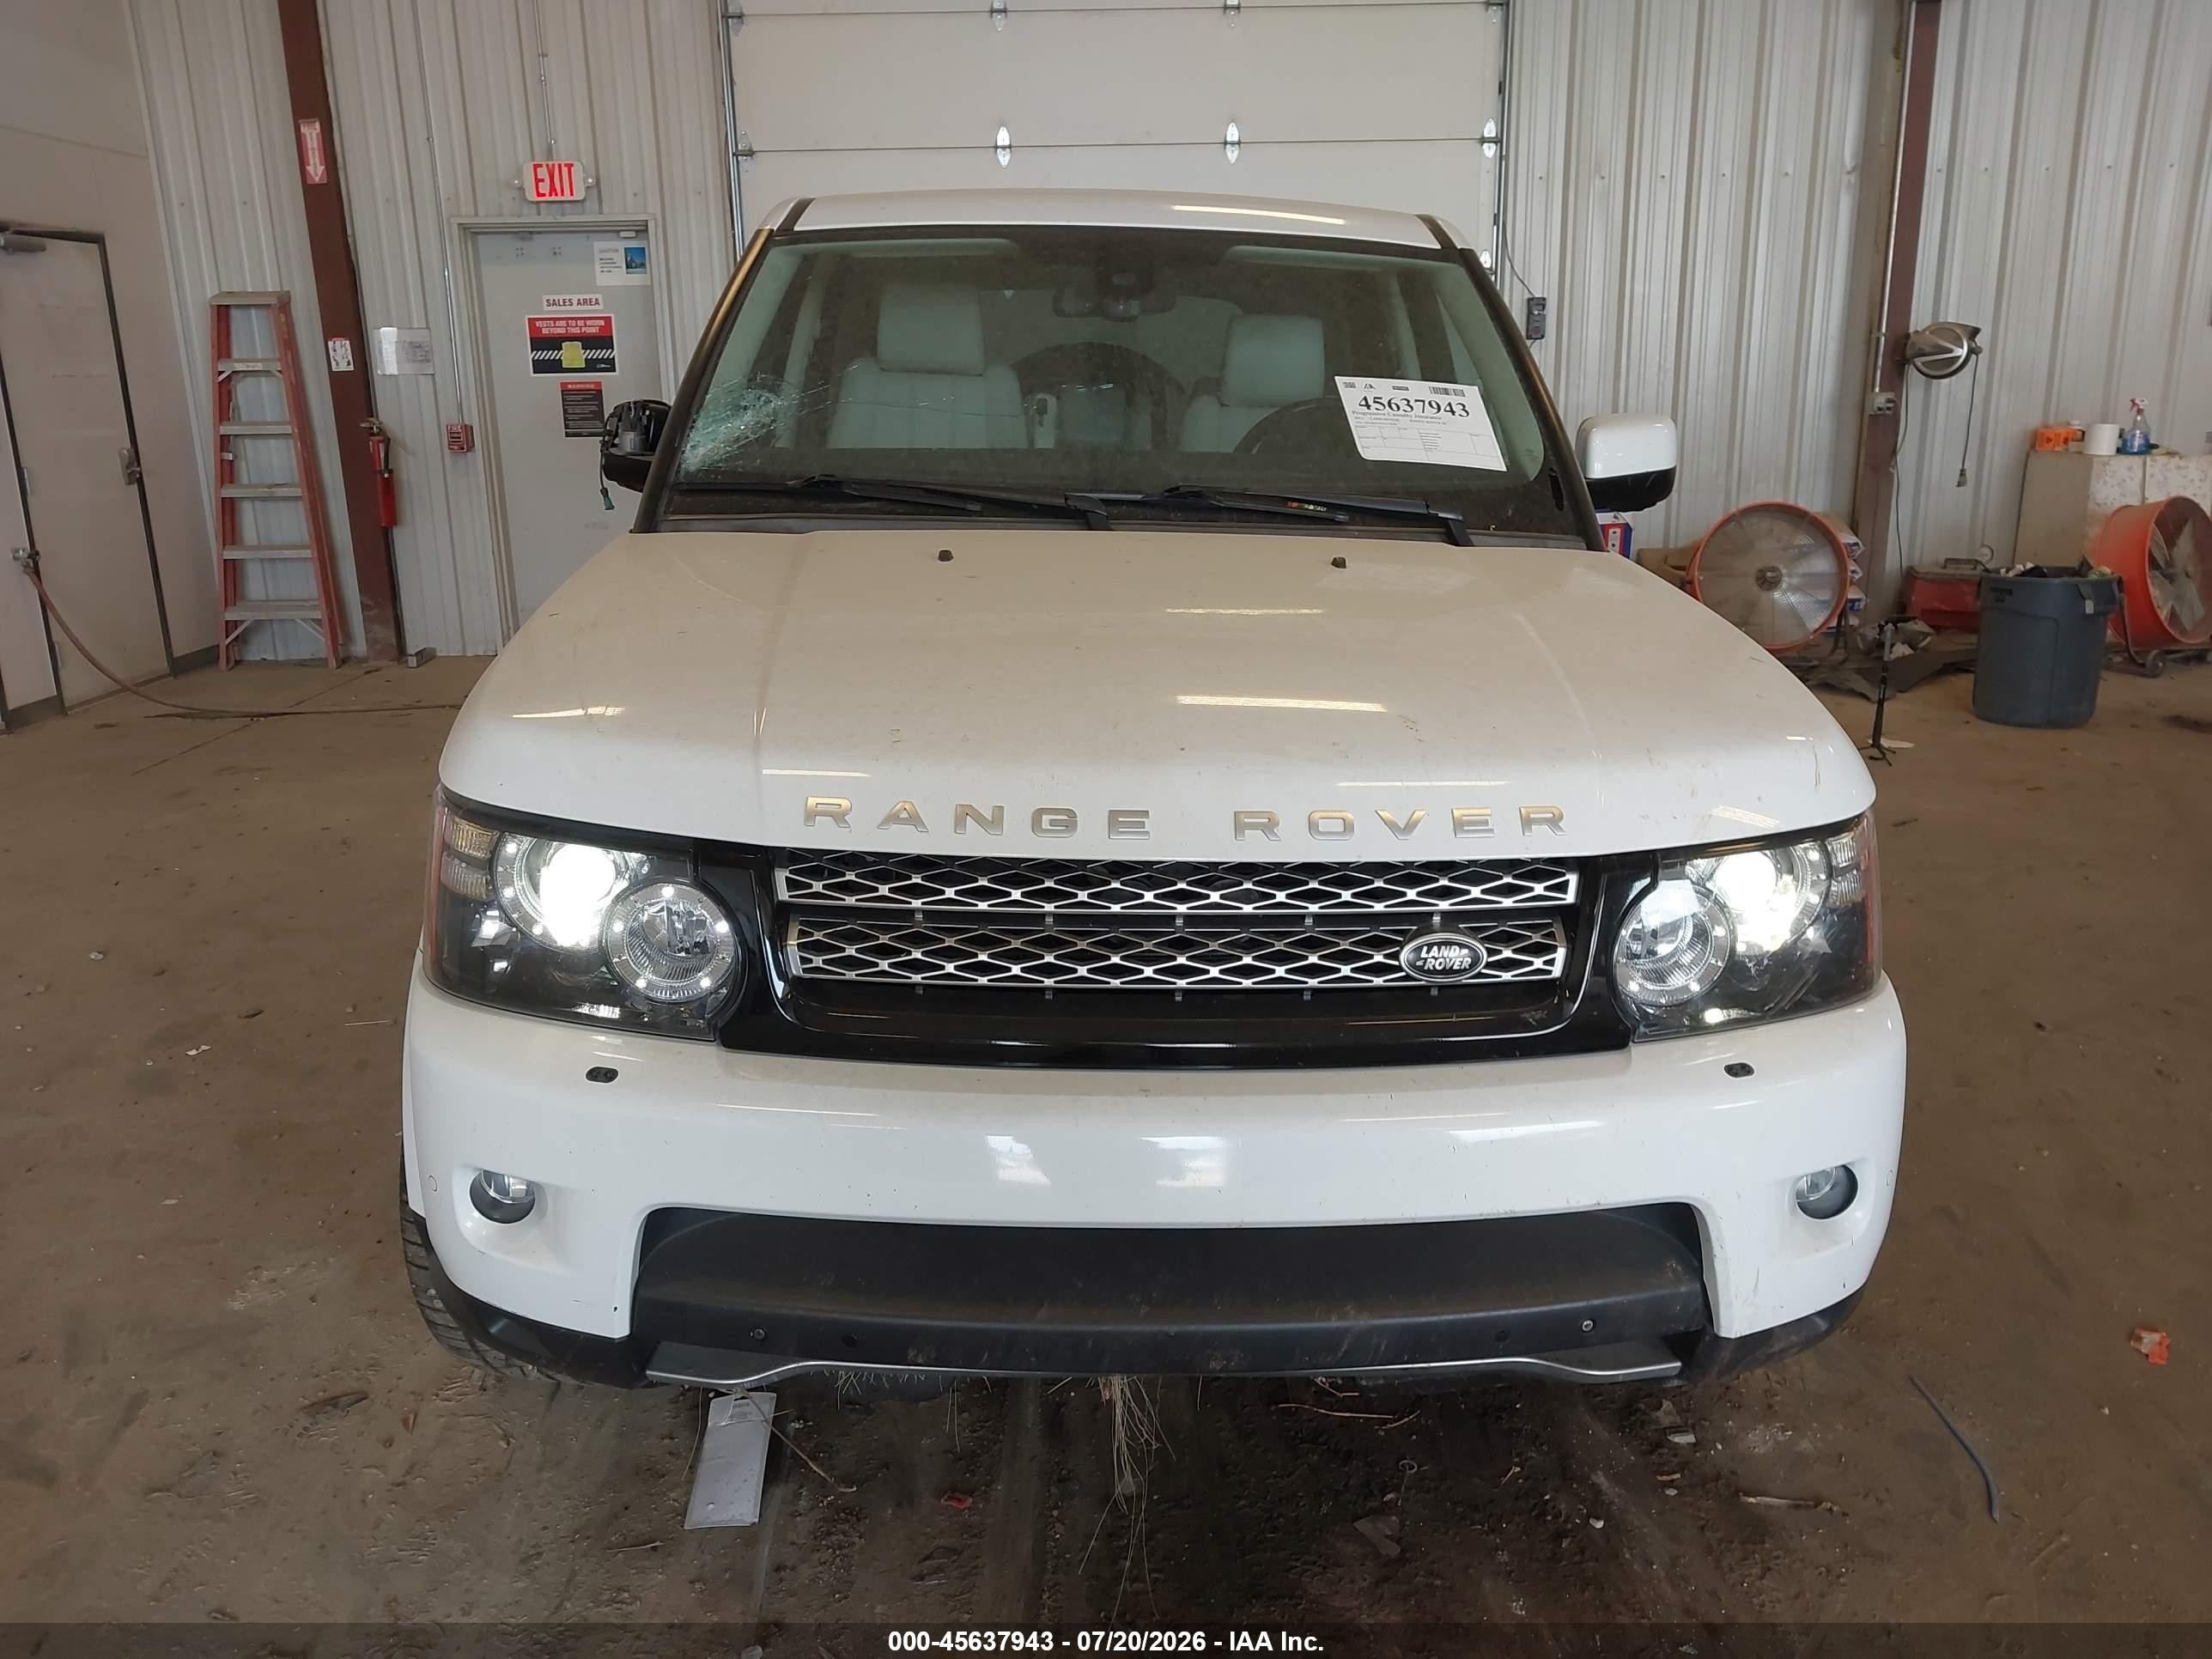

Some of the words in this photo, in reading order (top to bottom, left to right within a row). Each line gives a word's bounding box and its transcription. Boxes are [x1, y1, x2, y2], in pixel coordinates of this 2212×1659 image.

[532, 163, 574, 198] EXIT
[545, 298, 574, 307] SALES
[576, 297, 600, 307] AREA
[1358, 396, 1470, 417] 45637943
[804, 796, 1151, 840] RANGE
[1234, 804, 1567, 842] ROVER
[1420, 945, 1461, 958] LAND
[1424, 957, 1472, 970] ROVER
